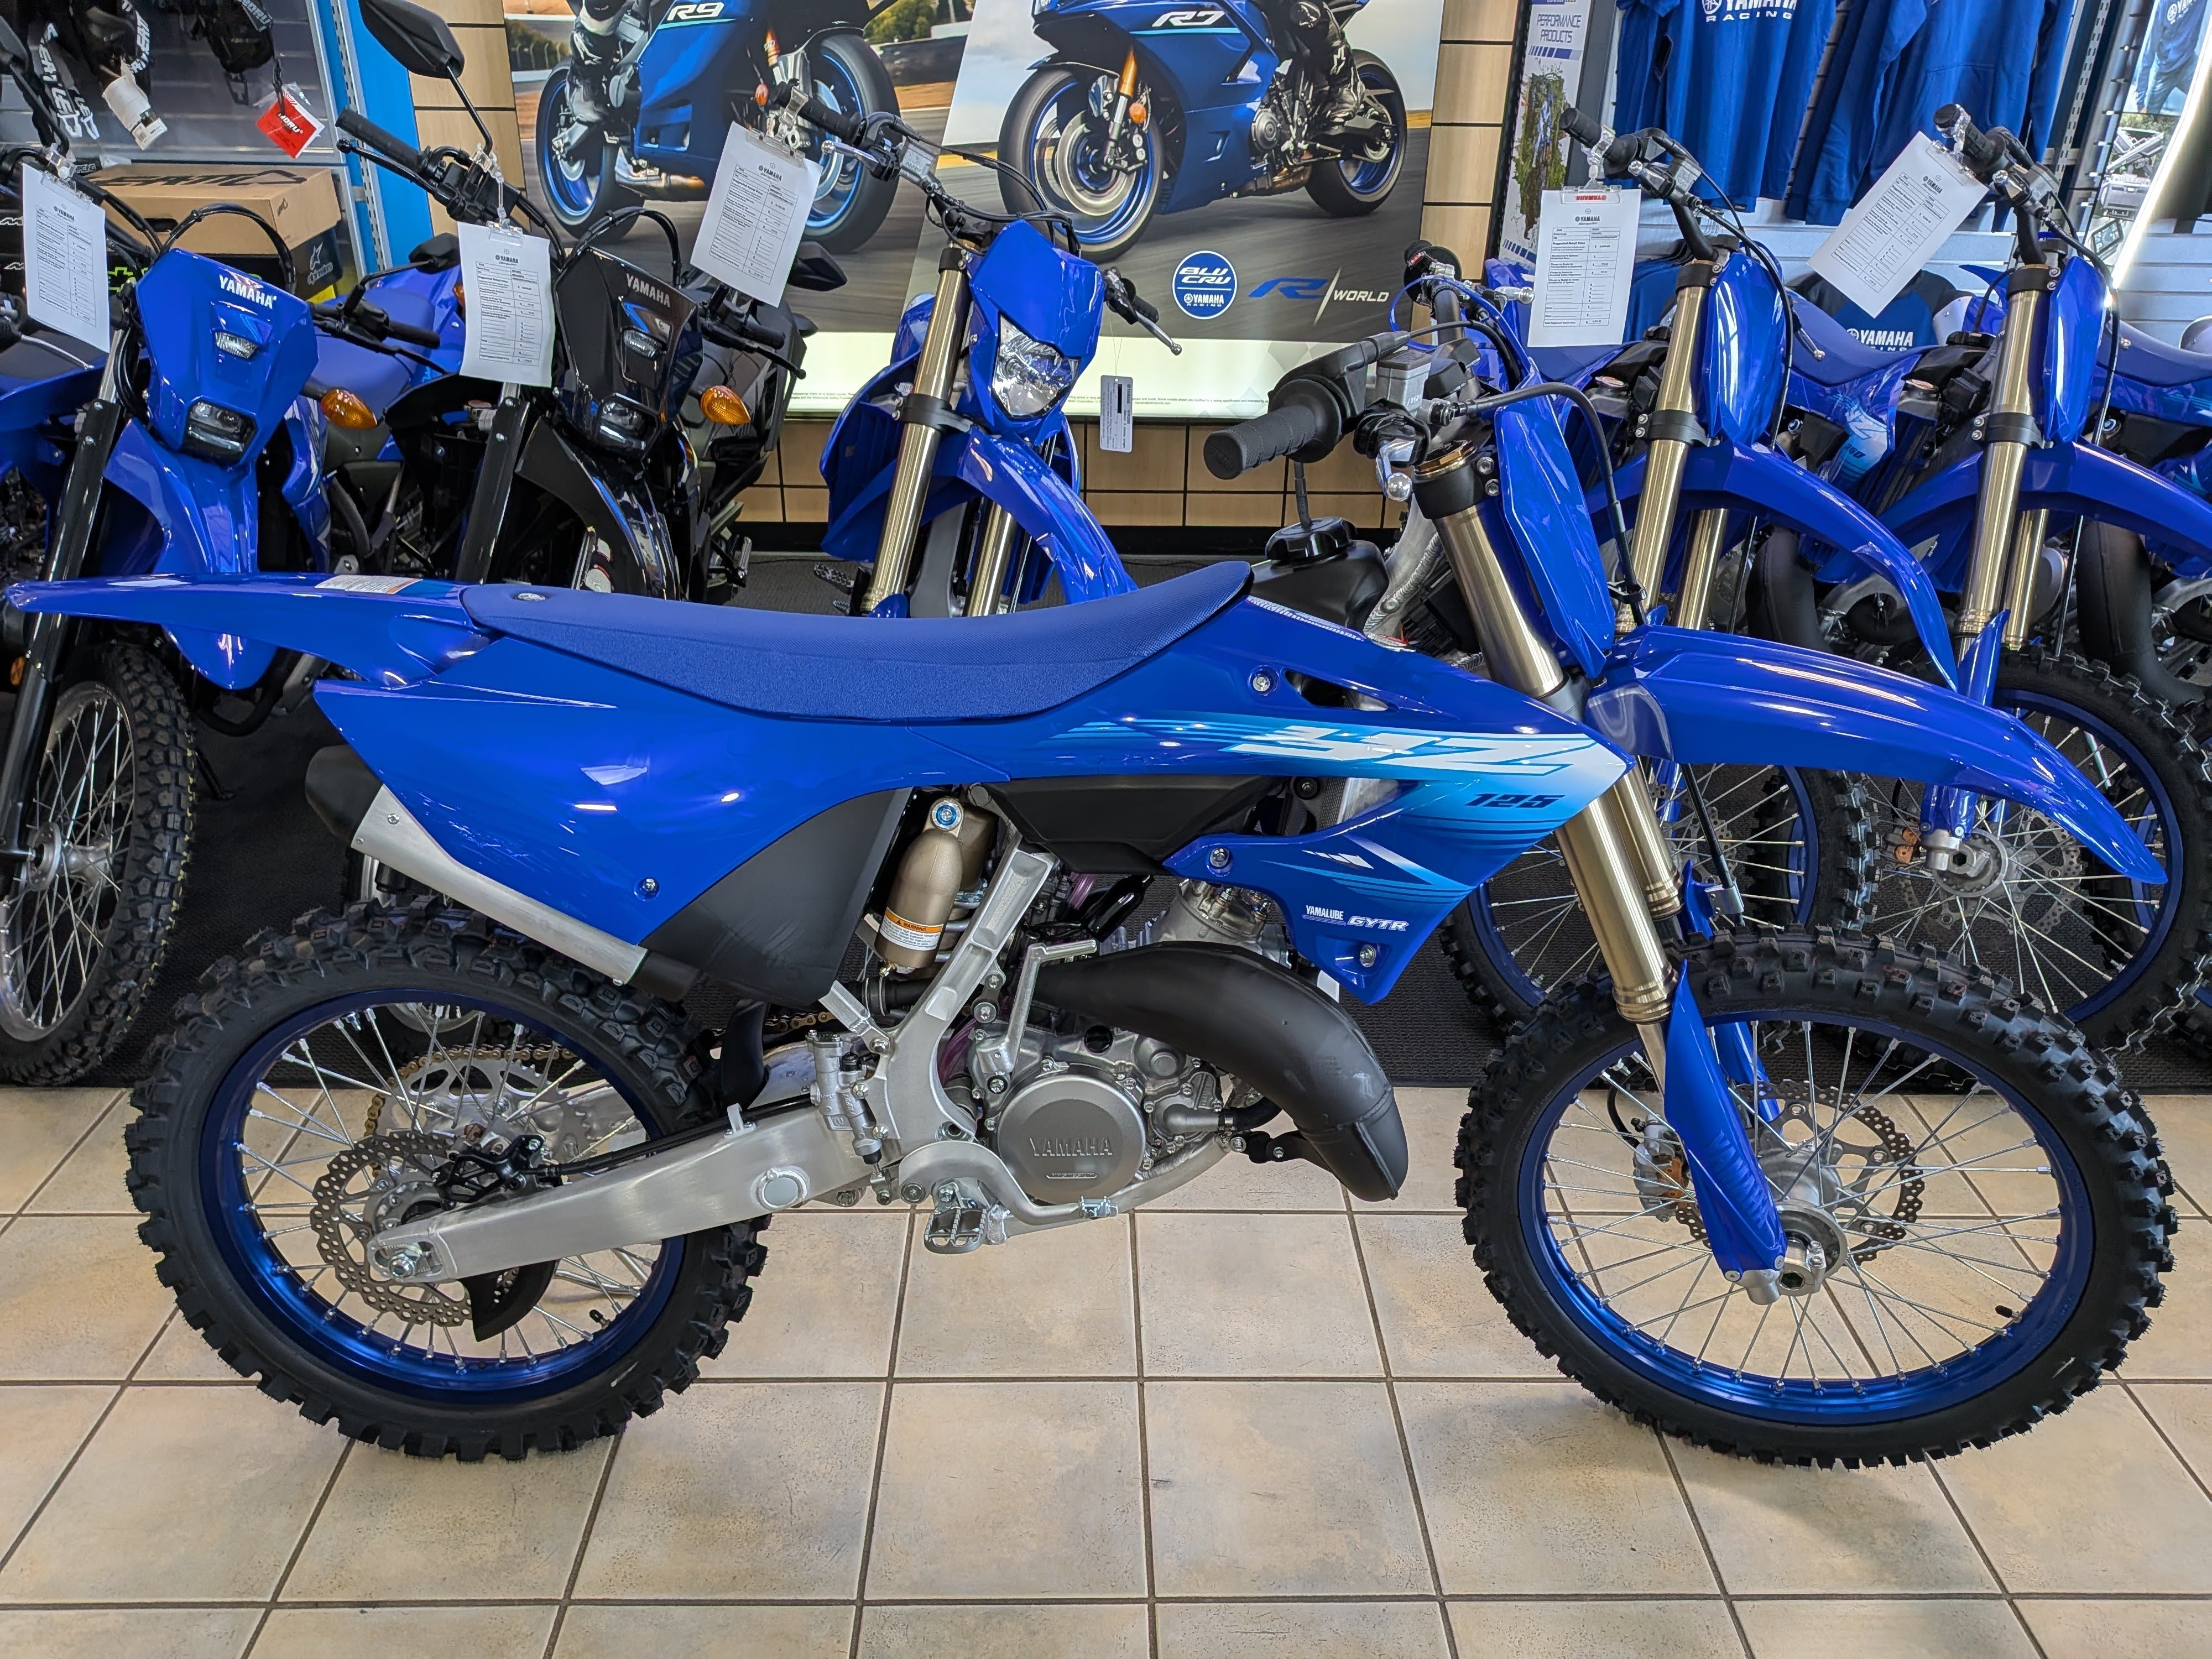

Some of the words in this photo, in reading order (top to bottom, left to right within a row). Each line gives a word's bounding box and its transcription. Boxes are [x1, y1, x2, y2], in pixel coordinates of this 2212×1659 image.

[666, 2, 724, 21] R9
[1705, 11, 1792, 23] RACING
[1151, 11, 1225, 27] R7
[1537, 14, 1582, 28] PERFORMANCE
[1540, 29, 1573, 43] PRODUCTS
[763, 166, 782, 181] YAMAHA
[1927, 179, 1943, 194] YAMAHA
[58, 208, 75, 221] YAMAHA
[500, 255, 519, 264] YAMAHA
[1178, 267, 1229, 275] BLU
[1181, 276, 1232, 284] CRU
[219, 274, 273, 310] YAMAHA
[626, 273, 670, 308] YAMAHA
[1333, 290, 1389, 302] WORLD
[1193, 293, 1224, 304] YAMAHA
[1860, 330, 1913, 347] YAMAHA
[1464, 794, 1566, 808] 125
[1306, 905, 1344, 920] YAMALUBE
[1347, 915, 1410, 931] GYTR
[903, 922, 926, 932] WARNING
[1029, 1137, 1113, 1156] YAMAHA
[1703, 1130, 1772, 1229] YAMAHA
